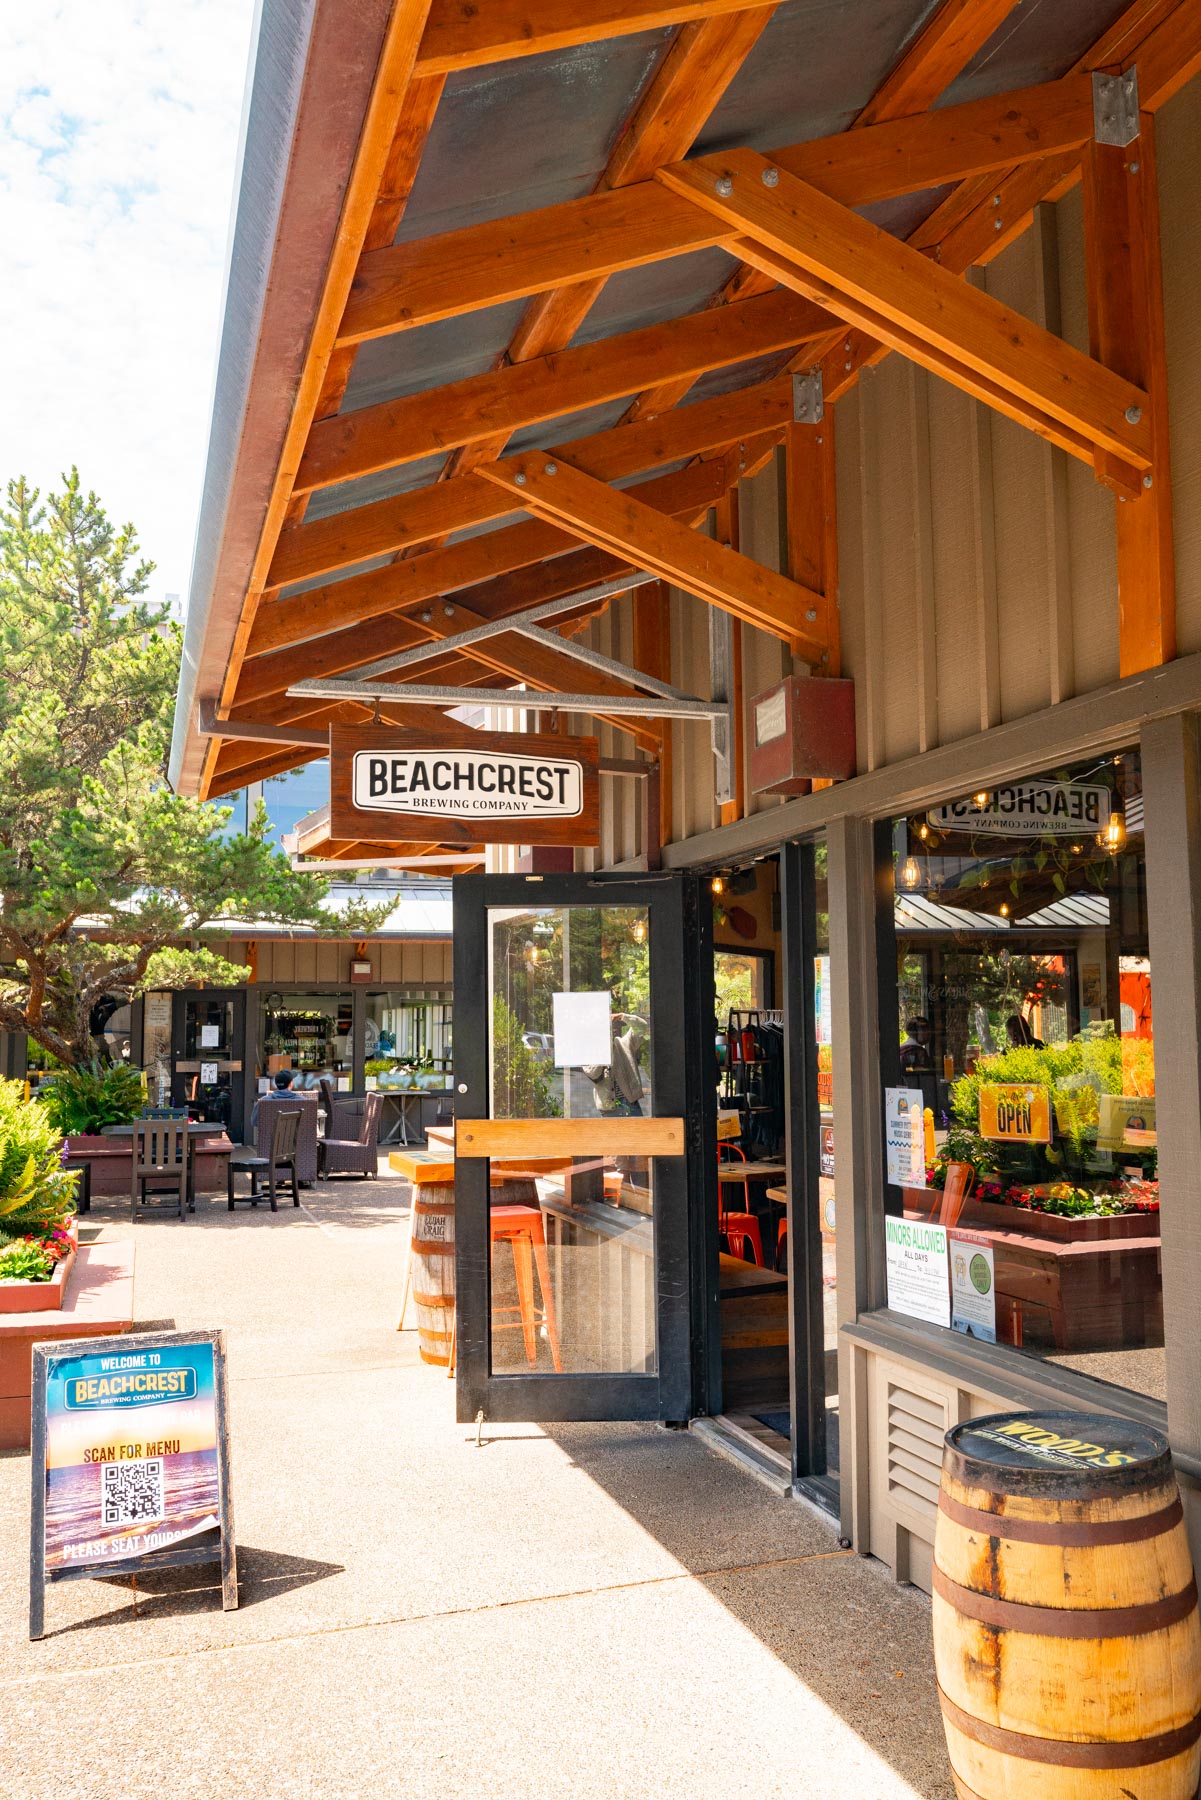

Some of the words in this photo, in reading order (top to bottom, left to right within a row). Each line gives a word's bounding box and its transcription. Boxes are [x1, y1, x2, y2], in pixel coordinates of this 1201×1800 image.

[369, 759, 570, 804] BEACHCREST
[413, 798, 470, 809] BREWING
[472, 800, 529, 811] COMPANY
[998, 1103, 1031, 1134] OPEN
[424, 1225, 445, 1236] CRAIG
[425, 1215, 446, 1225] ELIJAH
[887, 1222, 911, 1247] MINORS
[912, 1227, 945, 1254] ALLOWED
[904, 1250, 914, 1260] ALL
[914, 1252, 929, 1263] DAYS
[101, 1355, 147, 1371] WELCOME
[149, 1353, 161, 1366] TO
[75, 1370, 188, 1403] BEACHCREST
[100, 1396, 131, 1405] BREWING
[133, 1393, 165, 1402] COMPANY
[84, 1444, 116, 1463] SCAN
[120, 1443, 142, 1460] FOR
[146, 1439, 180, 1457] MENU
[995, 1421, 1139, 1467] WOOD'S
[63, 1542, 108, 1560] PLEASE
[111, 1536, 140, 1554] SEAT
